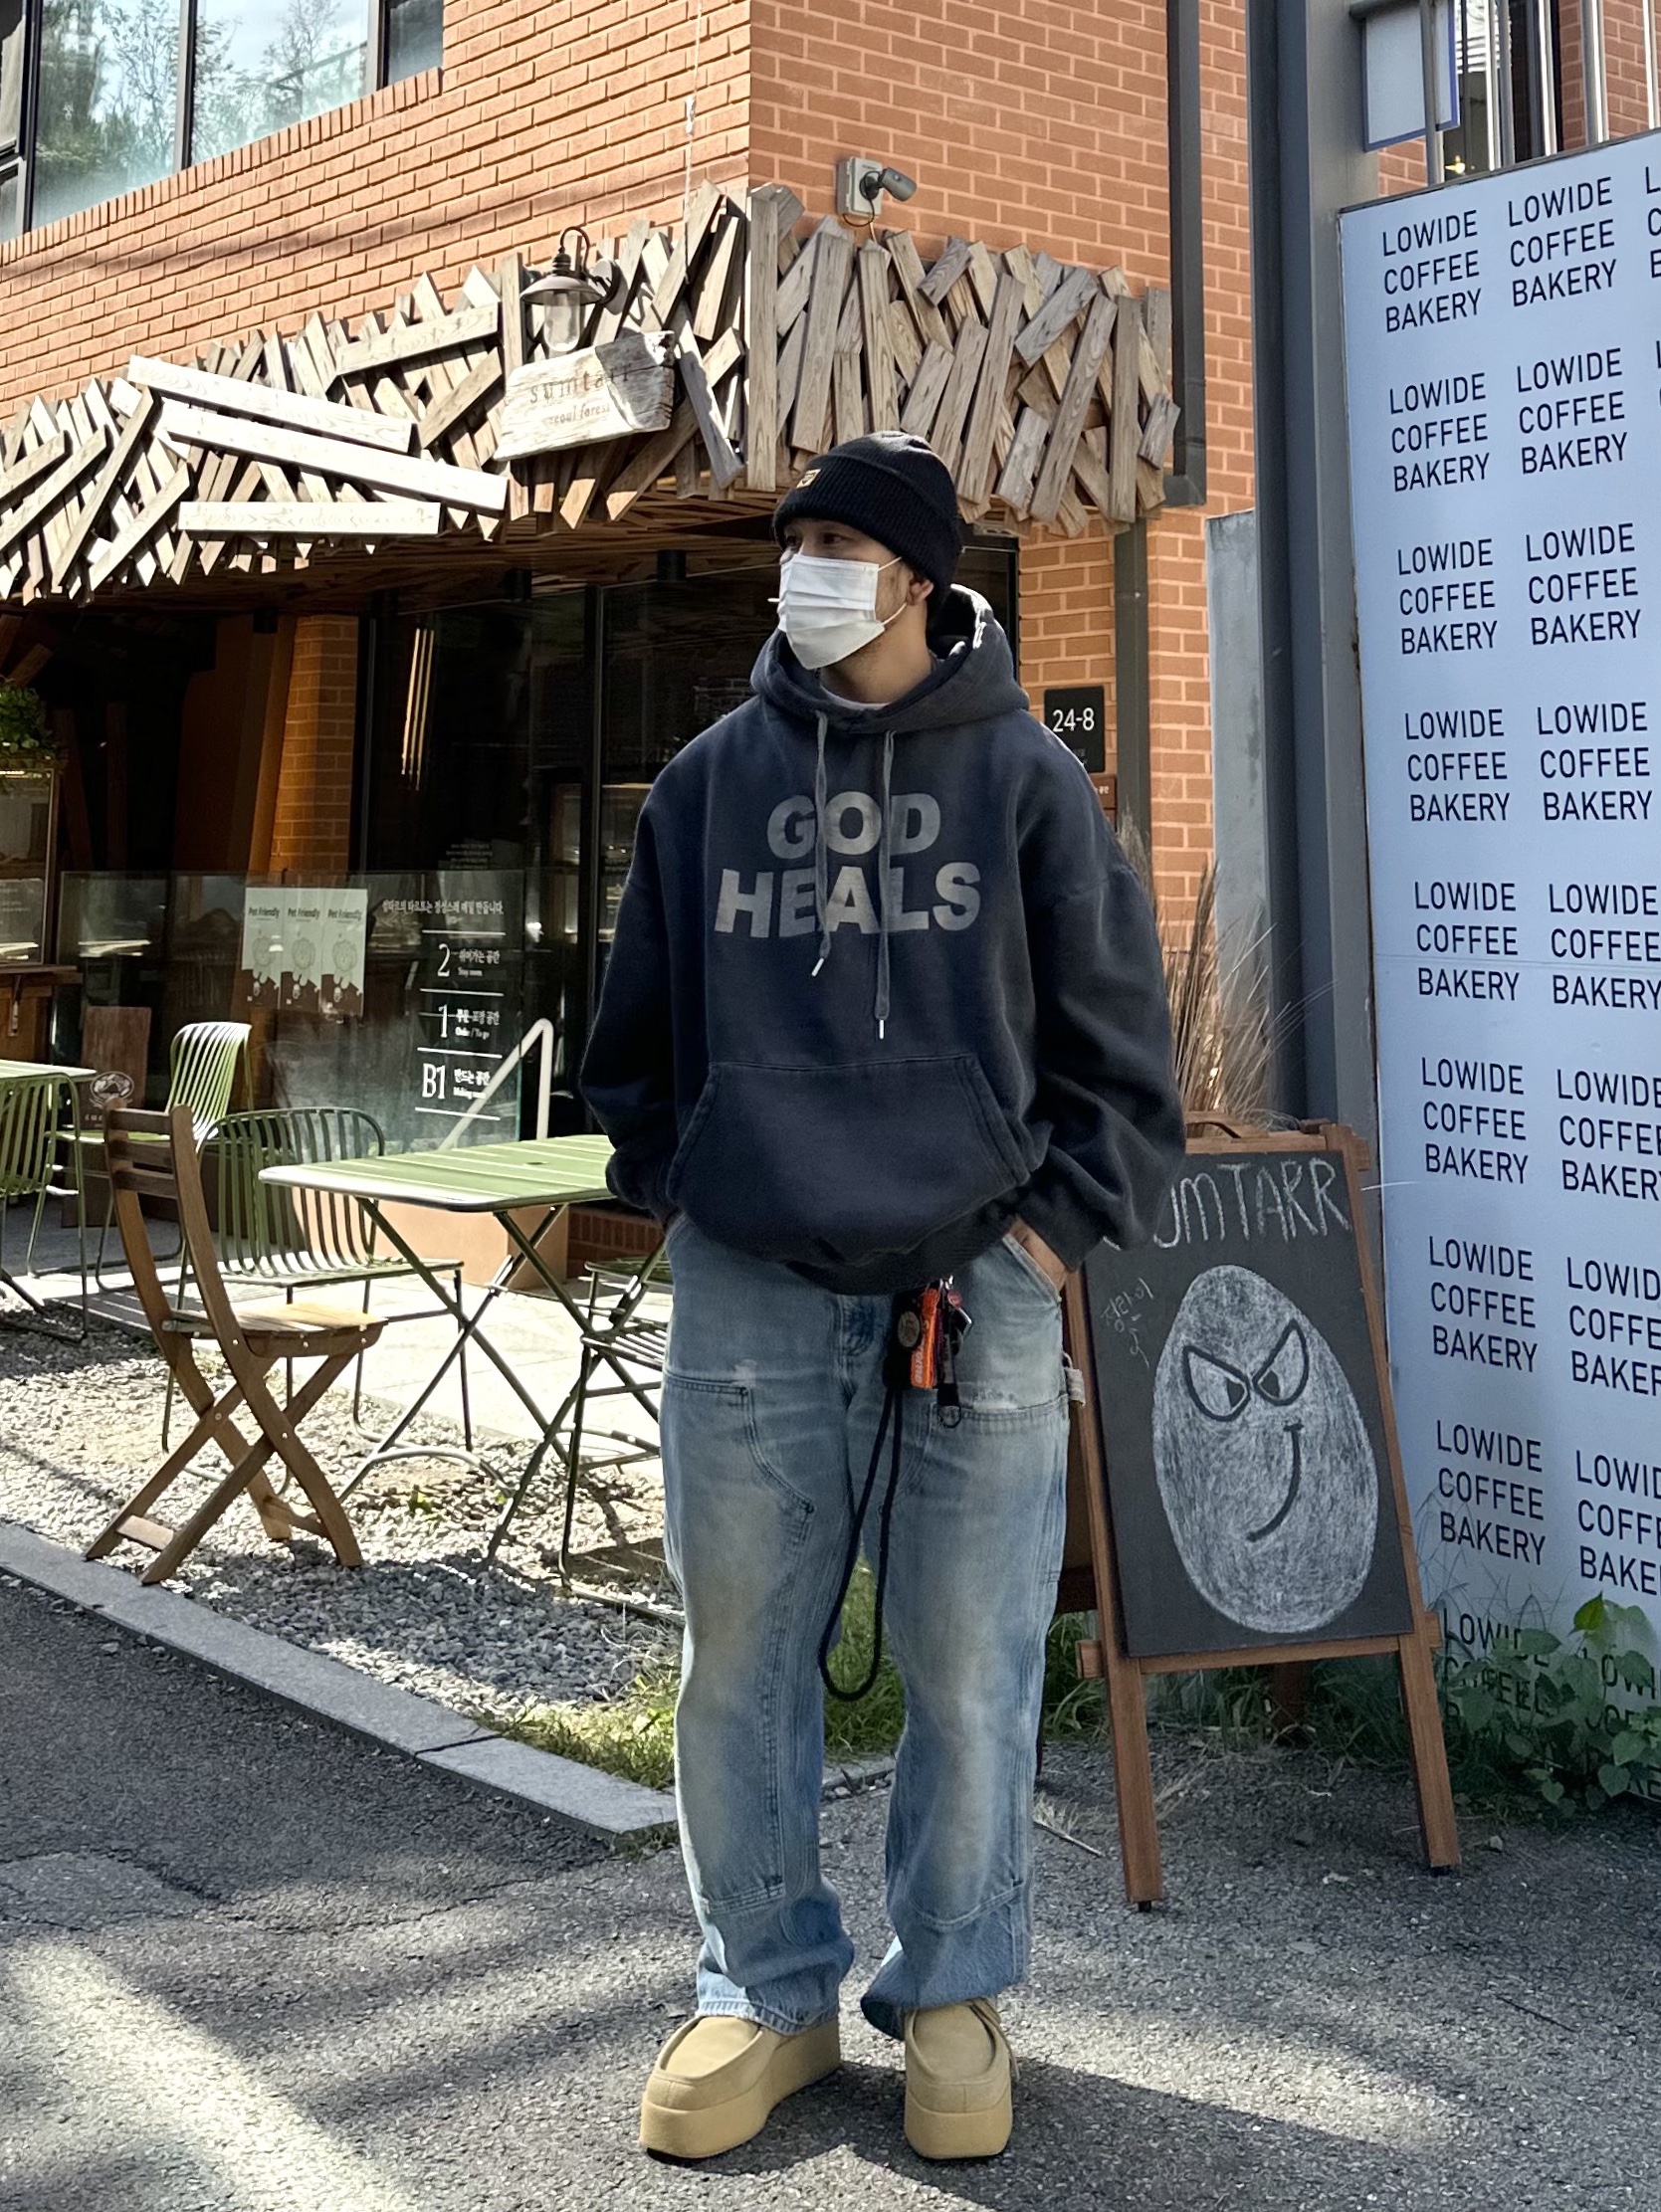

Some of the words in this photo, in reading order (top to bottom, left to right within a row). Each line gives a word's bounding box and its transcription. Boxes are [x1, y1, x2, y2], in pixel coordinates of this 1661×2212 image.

[1508, 176, 1613, 228] LOWIDE
[1382, 209, 1479, 258] LOWIDE
[1510, 218, 1615, 268] COFFEE
[1383, 249, 1480, 296] COFFEE
[1512, 258, 1617, 307] BAKERY
[1385, 287, 1482, 333] BAKERY
[1516, 347, 1623, 394] LOWIDE
[1389, 371, 1487, 415] LOWIDE
[1519, 390, 1625, 435] COFFEE
[1391, 412, 1489, 454] COFFEE
[1392, 452, 1491, 493] BAKERY
[1521, 431, 1628, 476] BAKERY
[1397, 537, 1494, 576] LOWIDE
[1525, 522, 1636, 562] LOWIDE
[1399, 579, 1496, 616] COFFEE
[1528, 566, 1639, 605] COFFEE
[1400, 619, 1498, 656] BAKERY
[1531, 608, 1642, 646] BAKERY
[1053, 707, 1095, 732] 24-8
[1404, 707, 1505, 740] LOWIDE
[1537, 701, 1648, 735] LOWIDE
[1407, 750, 1508, 782] COFFEE
[1540, 746, 1651, 779] COFFEE
[767, 791, 940, 859] GOD
[1409, 792, 1511, 822] BAKERY
[1543, 789, 1653, 821] BAKERY
[714, 862, 981, 938] HEALS
[1414, 881, 1517, 912] LOWIDE
[1549, 883, 1659, 916] LOWIDE
[1416, 923, 1519, 956] COFFEE
[1551, 927, 1661, 963] COFFEE
[438, 943, 451, 977] 2
[1417, 966, 1521, 1002] BAKERY
[1552, 974, 1661, 1011] BAKERY
[438, 1003, 448, 1038] 1
[422, 1063, 446, 1100] B1
[1421, 1057, 1525, 1096] LOWIDE
[1423, 1101, 1527, 1141] COFFEE
[1425, 1142, 1529, 1185] BAKERY
[1561, 1158, 1661, 1202] BAKER
[1428, 1235, 1535, 1282] LOWIDE
[1430, 1282, 1537, 1329] COFFEE
[1432, 1324, 1539, 1373] BAKERY
[1436, 1419, 1543, 1473] LOWIDE
[1438, 1467, 1545, 1521] COFFEE
[1440, 1510, 1547, 1566] BAKERY
[1577, 1499, 1661, 1550] COFF
[1579, 1544, 1661, 1597] BAKE
